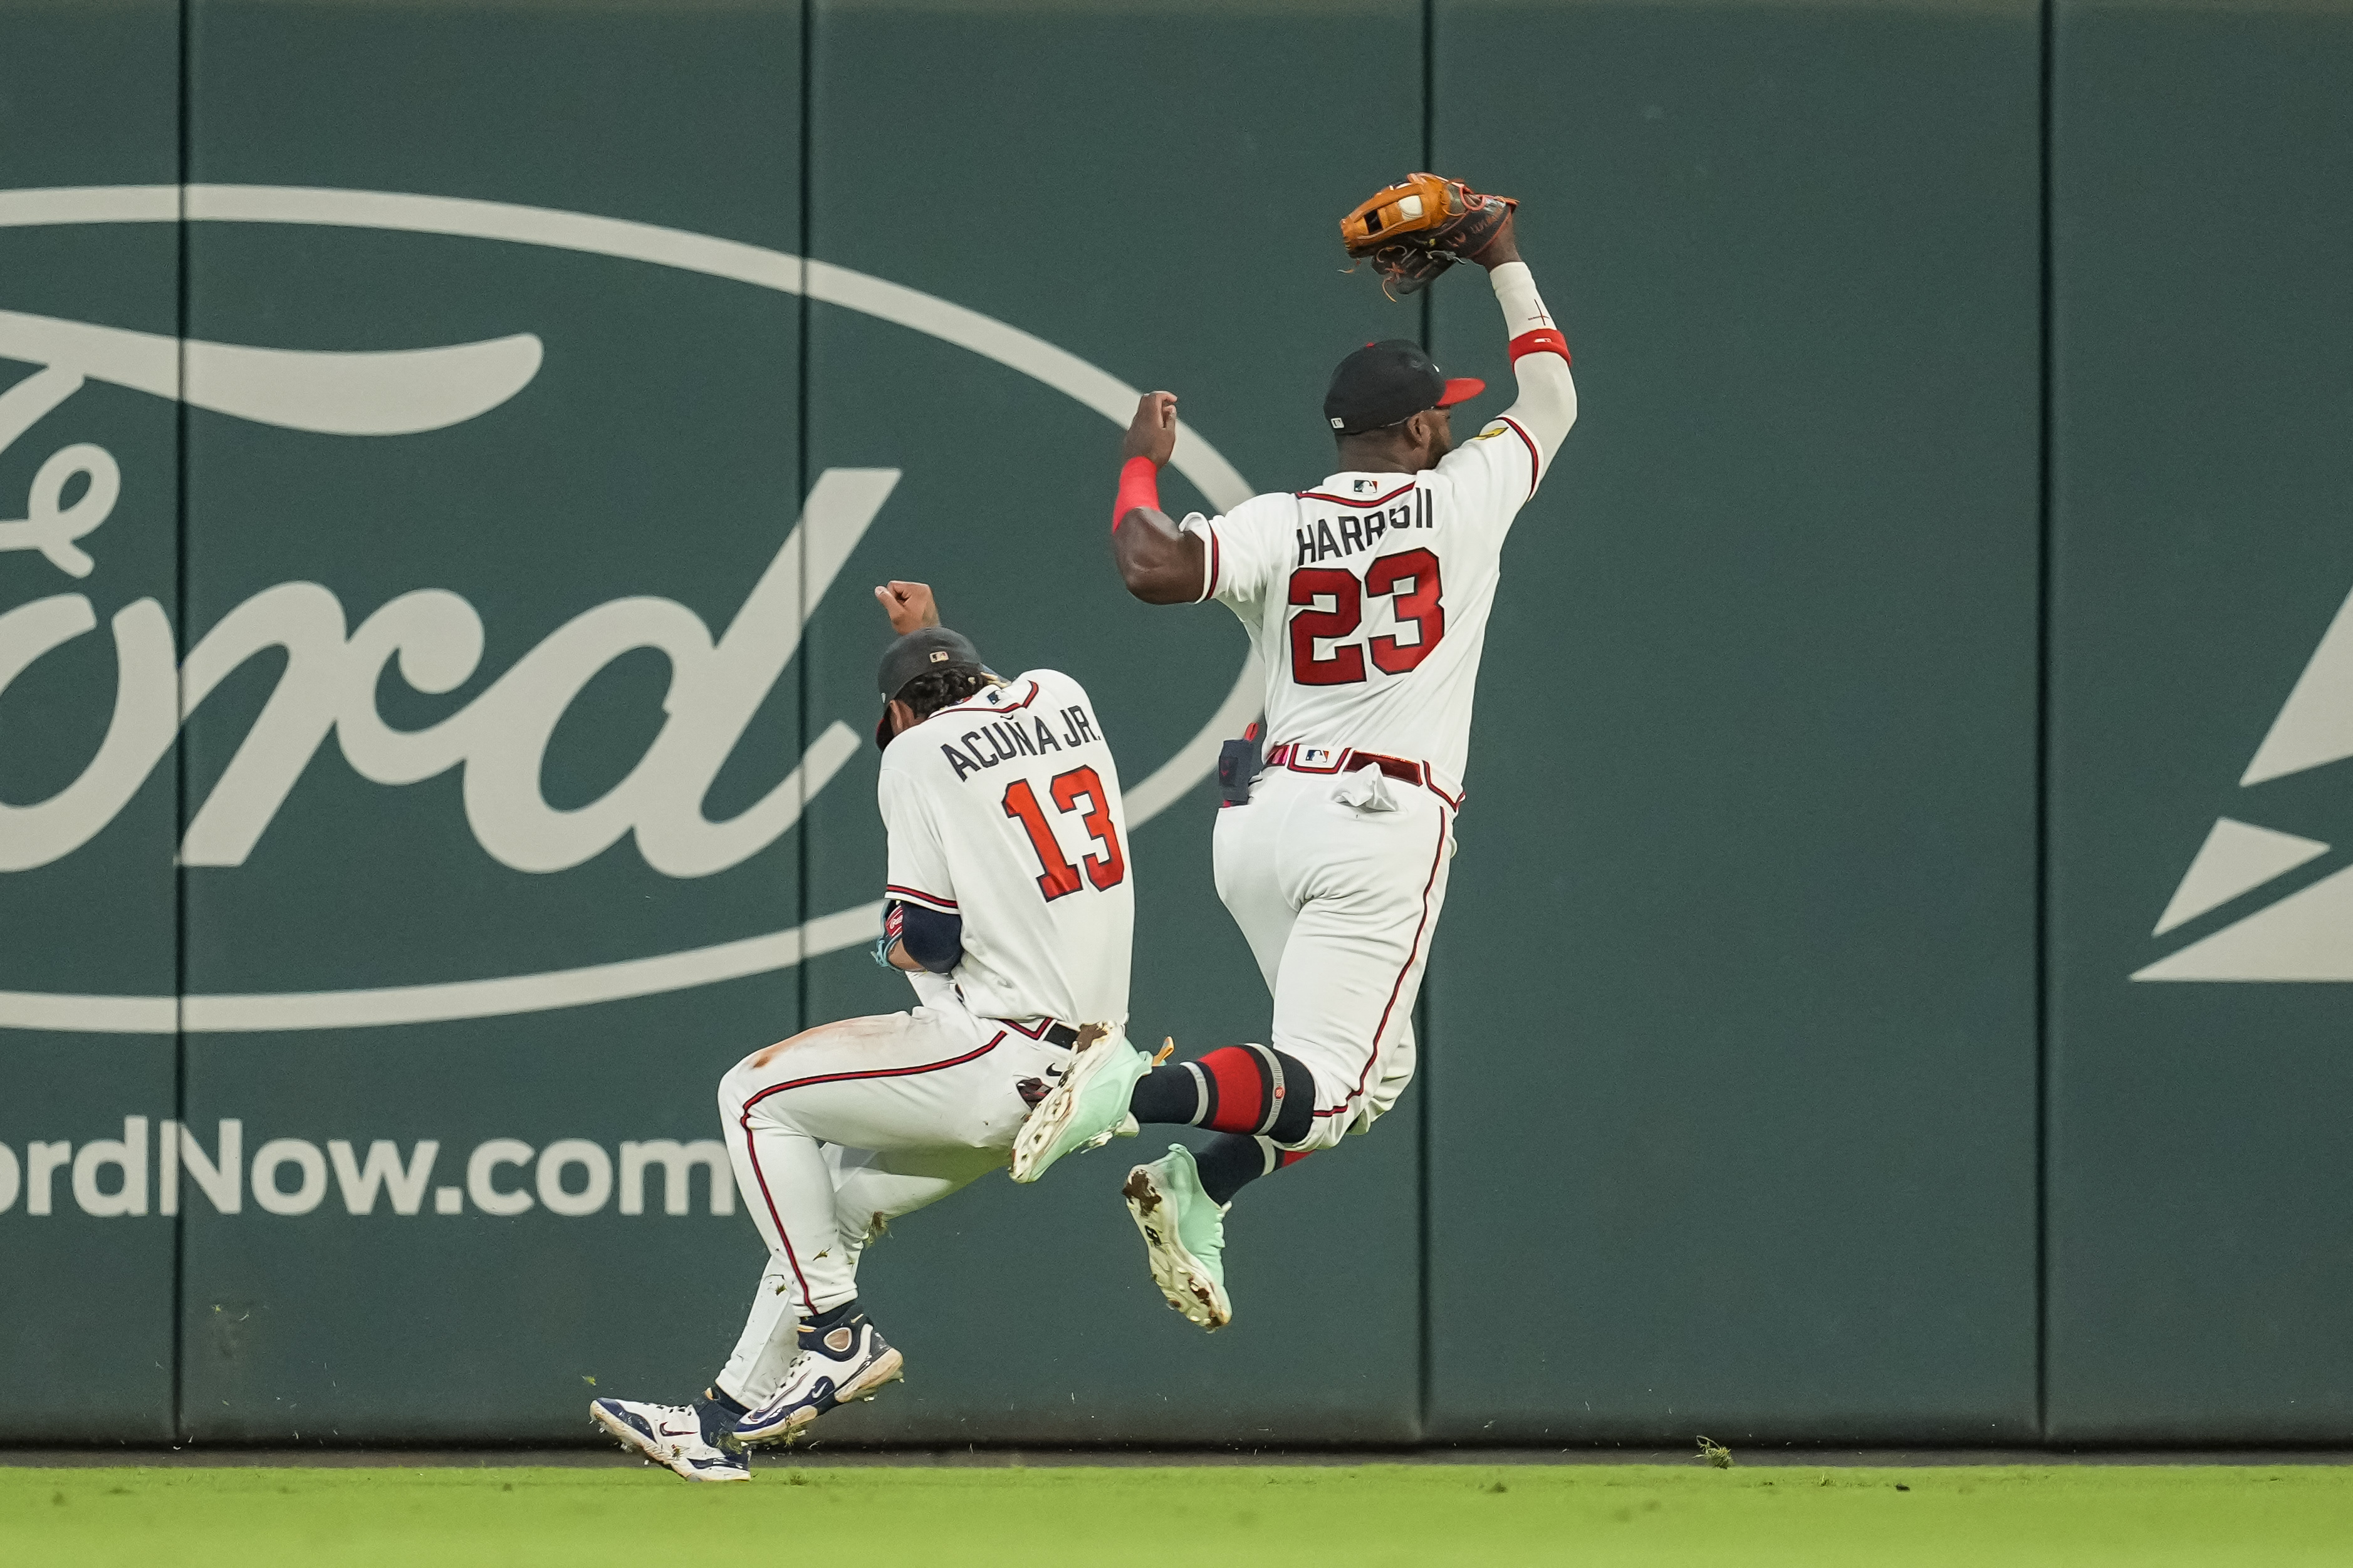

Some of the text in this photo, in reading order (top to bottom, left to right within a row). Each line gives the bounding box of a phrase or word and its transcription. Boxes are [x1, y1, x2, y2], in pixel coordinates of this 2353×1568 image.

[1288, 547, 1445, 686] 23
[940, 705, 1101, 782] ACUÑA JR.
[1001, 764, 1125, 903] 13
[0, 1114, 736, 1217] rdNow.com
